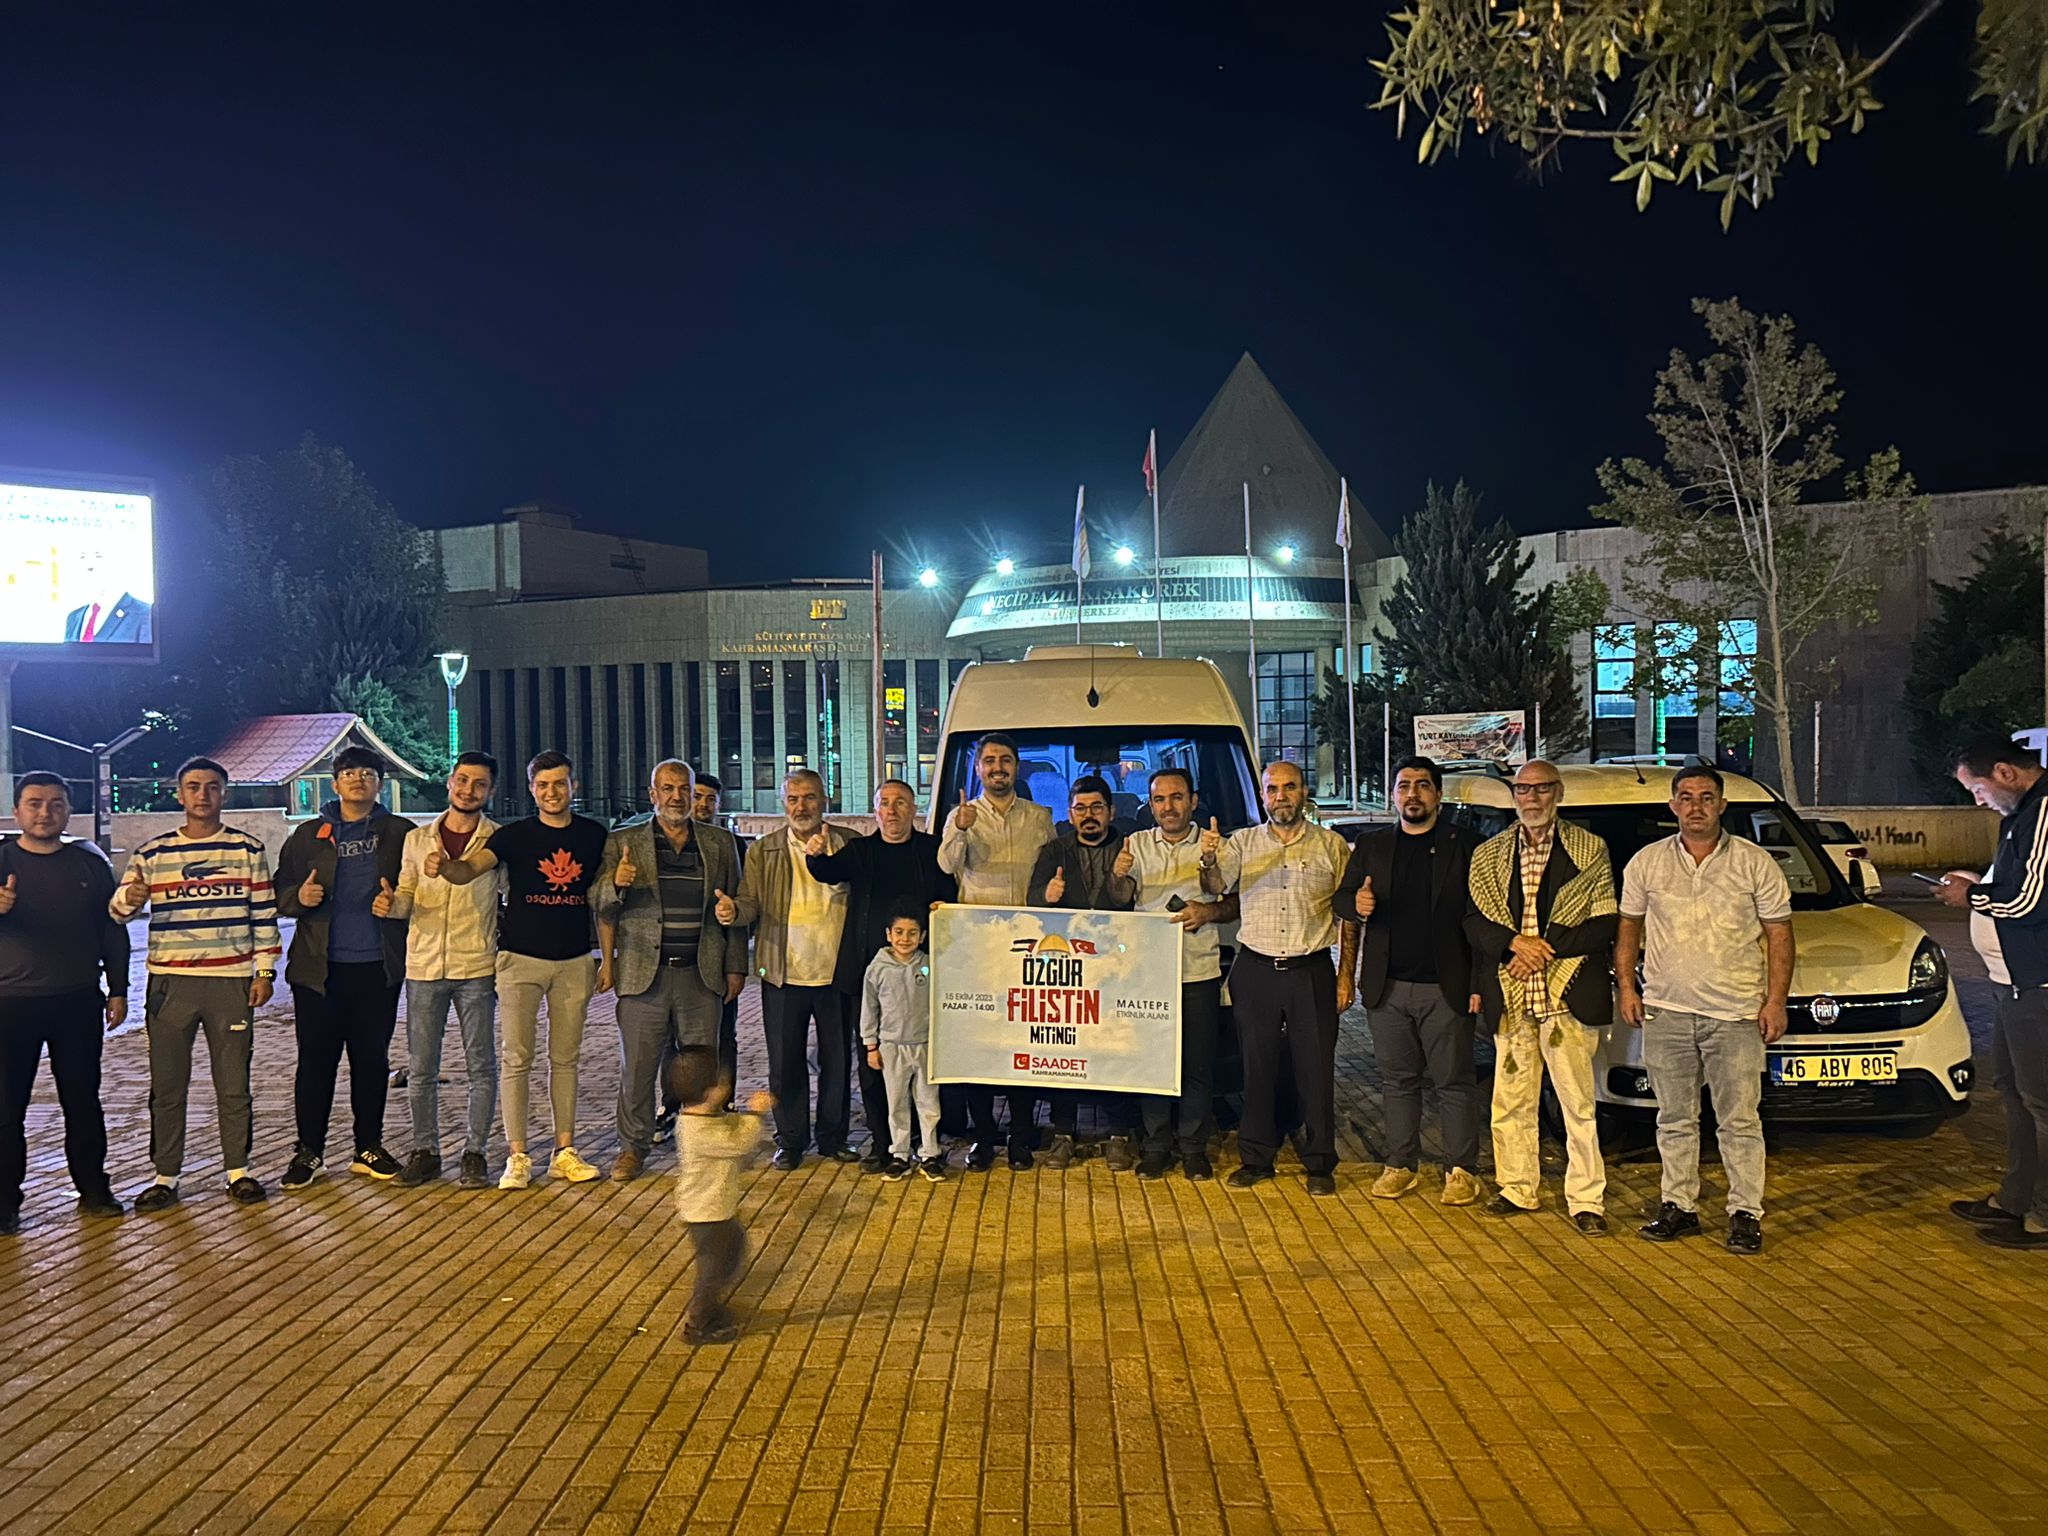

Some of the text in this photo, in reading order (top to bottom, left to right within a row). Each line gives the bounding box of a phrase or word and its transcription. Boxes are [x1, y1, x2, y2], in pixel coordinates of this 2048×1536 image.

[165, 883, 243, 900] LACOSTE
[1023, 954, 1083, 987] ÖZGÜR
[945, 993, 954, 1001] 15
[1116, 999, 1169, 1010] MALTEPE
[1816, 1004, 1832, 1018] FIAT
[1147, 1012, 1169, 1020] ALANI
[1032, 1057, 1088, 1071] SAADET
[1784, 1059, 1806, 1078] 46
[1861, 1057, 1893, 1076] 805
[1032, 1070, 1087, 1079] KAHRAMANMARAŞ
